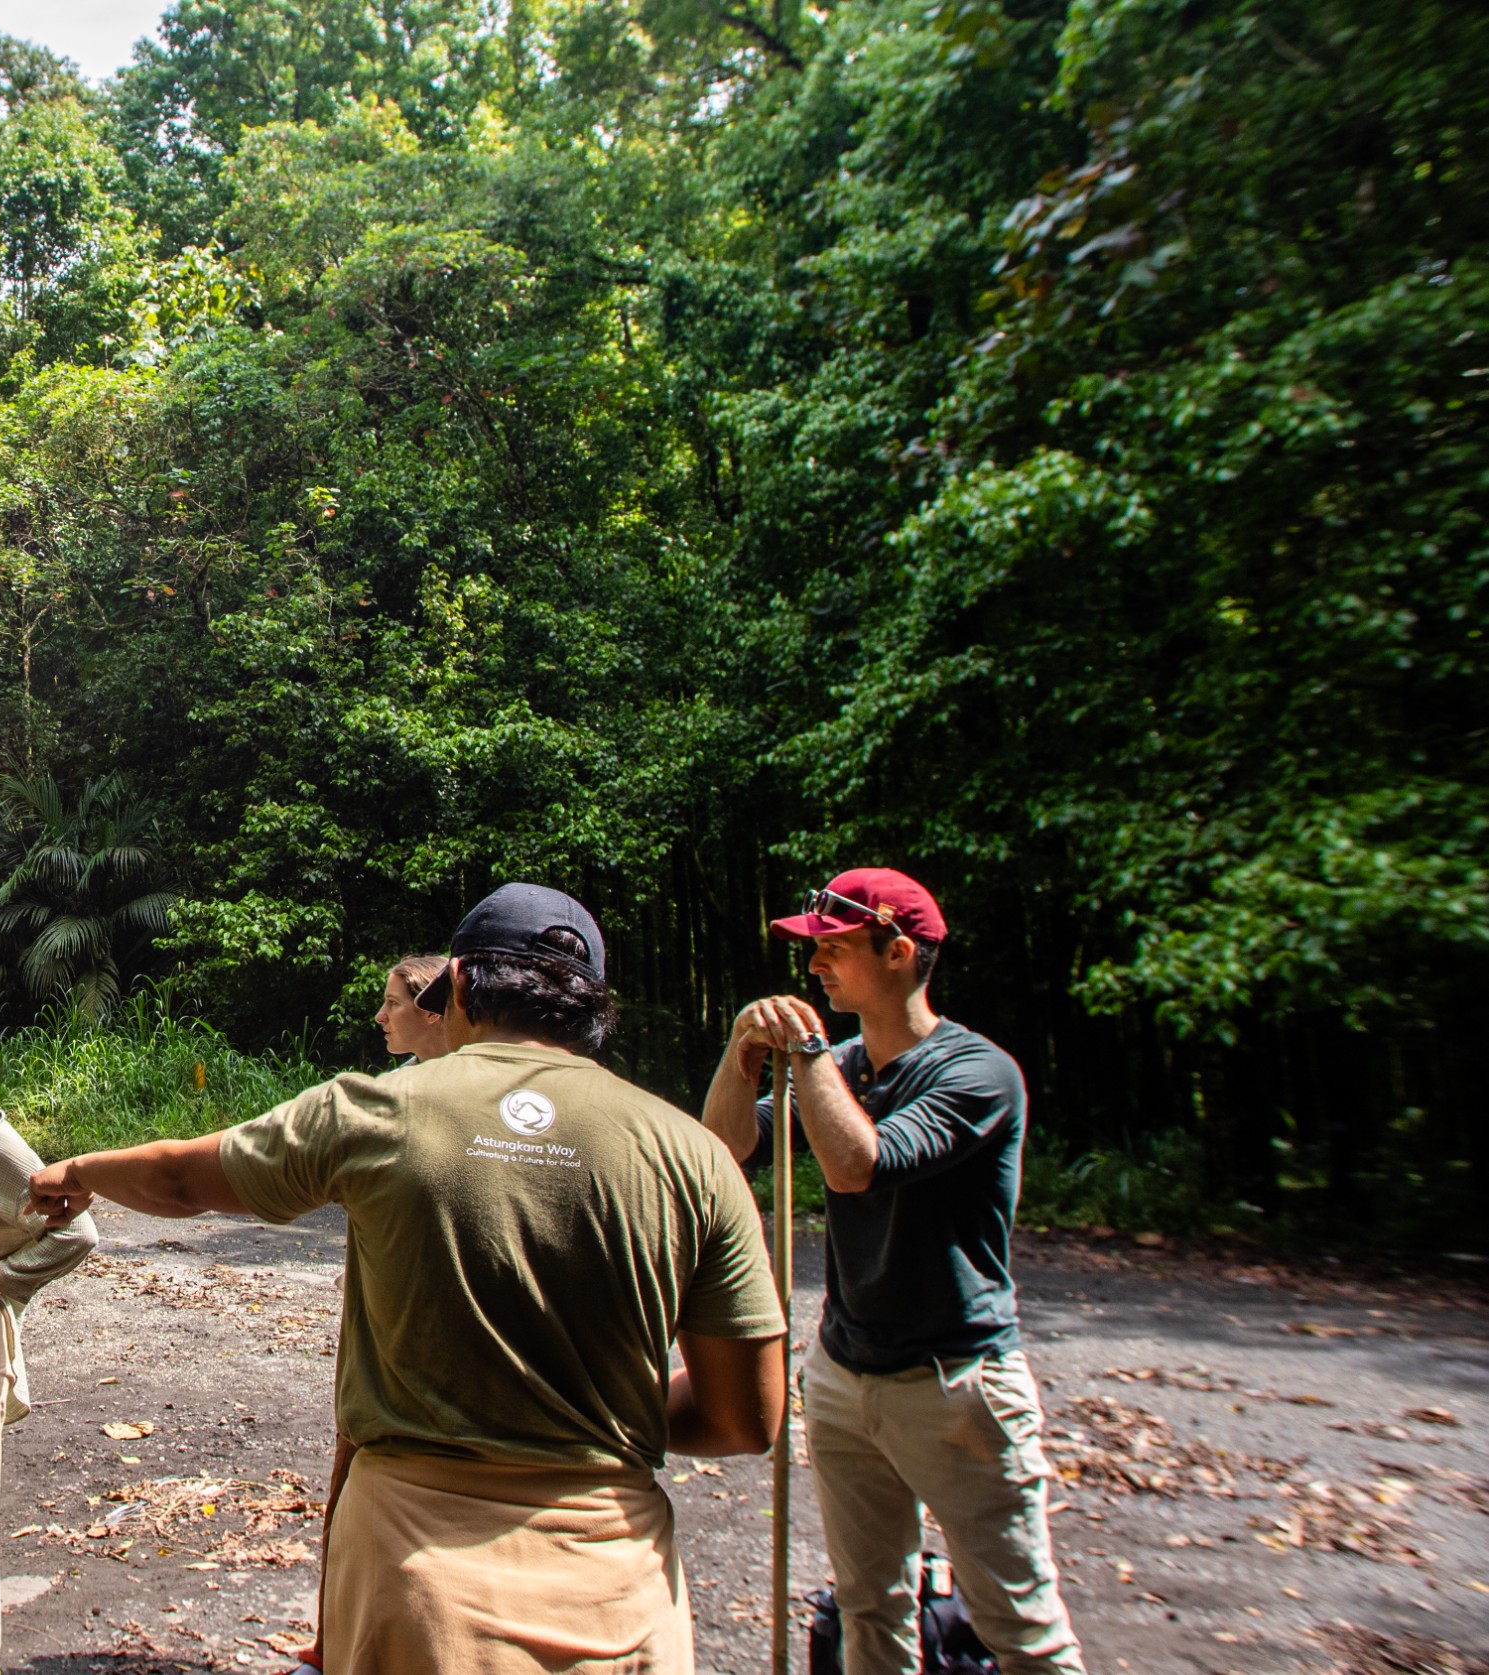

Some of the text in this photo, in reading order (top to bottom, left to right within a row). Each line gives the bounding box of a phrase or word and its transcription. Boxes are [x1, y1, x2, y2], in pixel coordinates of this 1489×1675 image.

[466, 1147, 509, 1162] Cultivating
[518, 1154, 544, 1165] Future
[546, 1158, 558, 1167] for
[560, 1159, 581, 1168] Food
[473, 1135, 576, 1158] Astungkara Way
